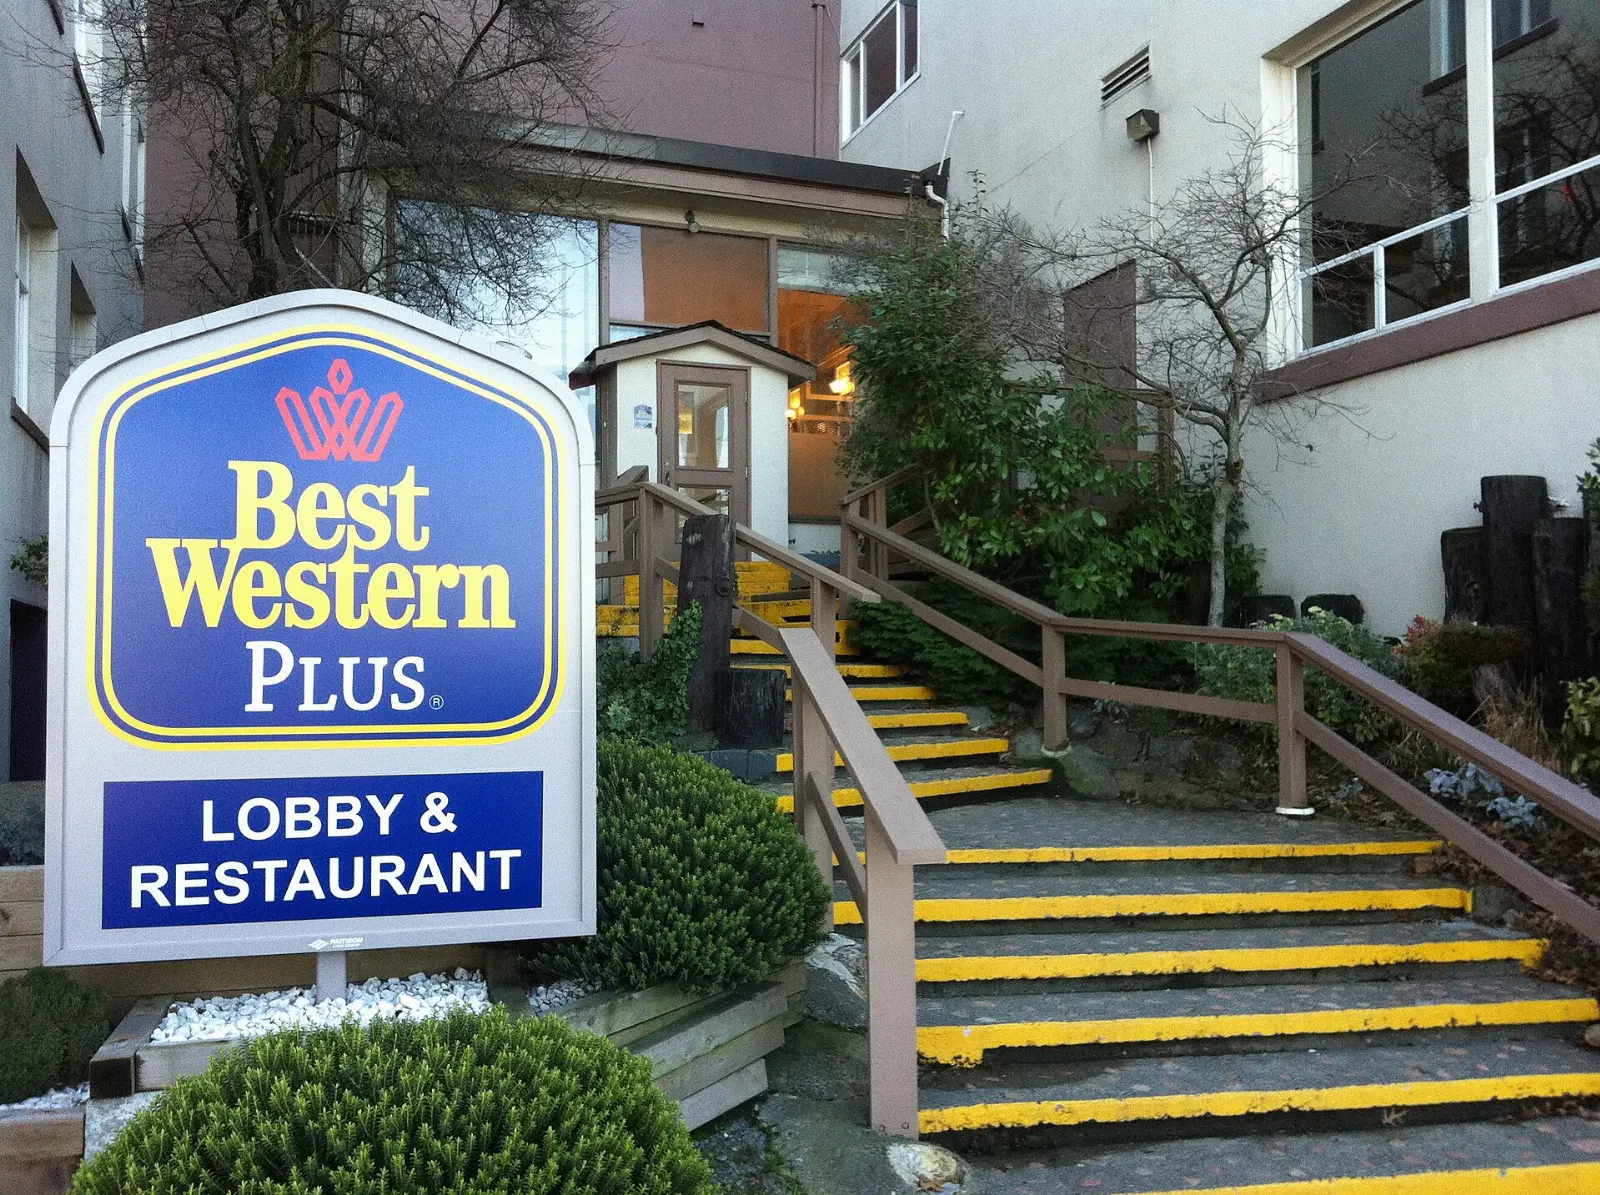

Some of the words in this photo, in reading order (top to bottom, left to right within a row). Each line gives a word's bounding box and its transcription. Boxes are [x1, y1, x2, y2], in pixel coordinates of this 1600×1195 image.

[228, 460, 430, 552] Best
[145, 535, 516, 629] Western
[243, 640, 425, 712] PLUS
[201, 793, 404, 842] LOBBY
[419, 791, 458, 834] &
[130, 849, 522, 908] RESTAURANT
